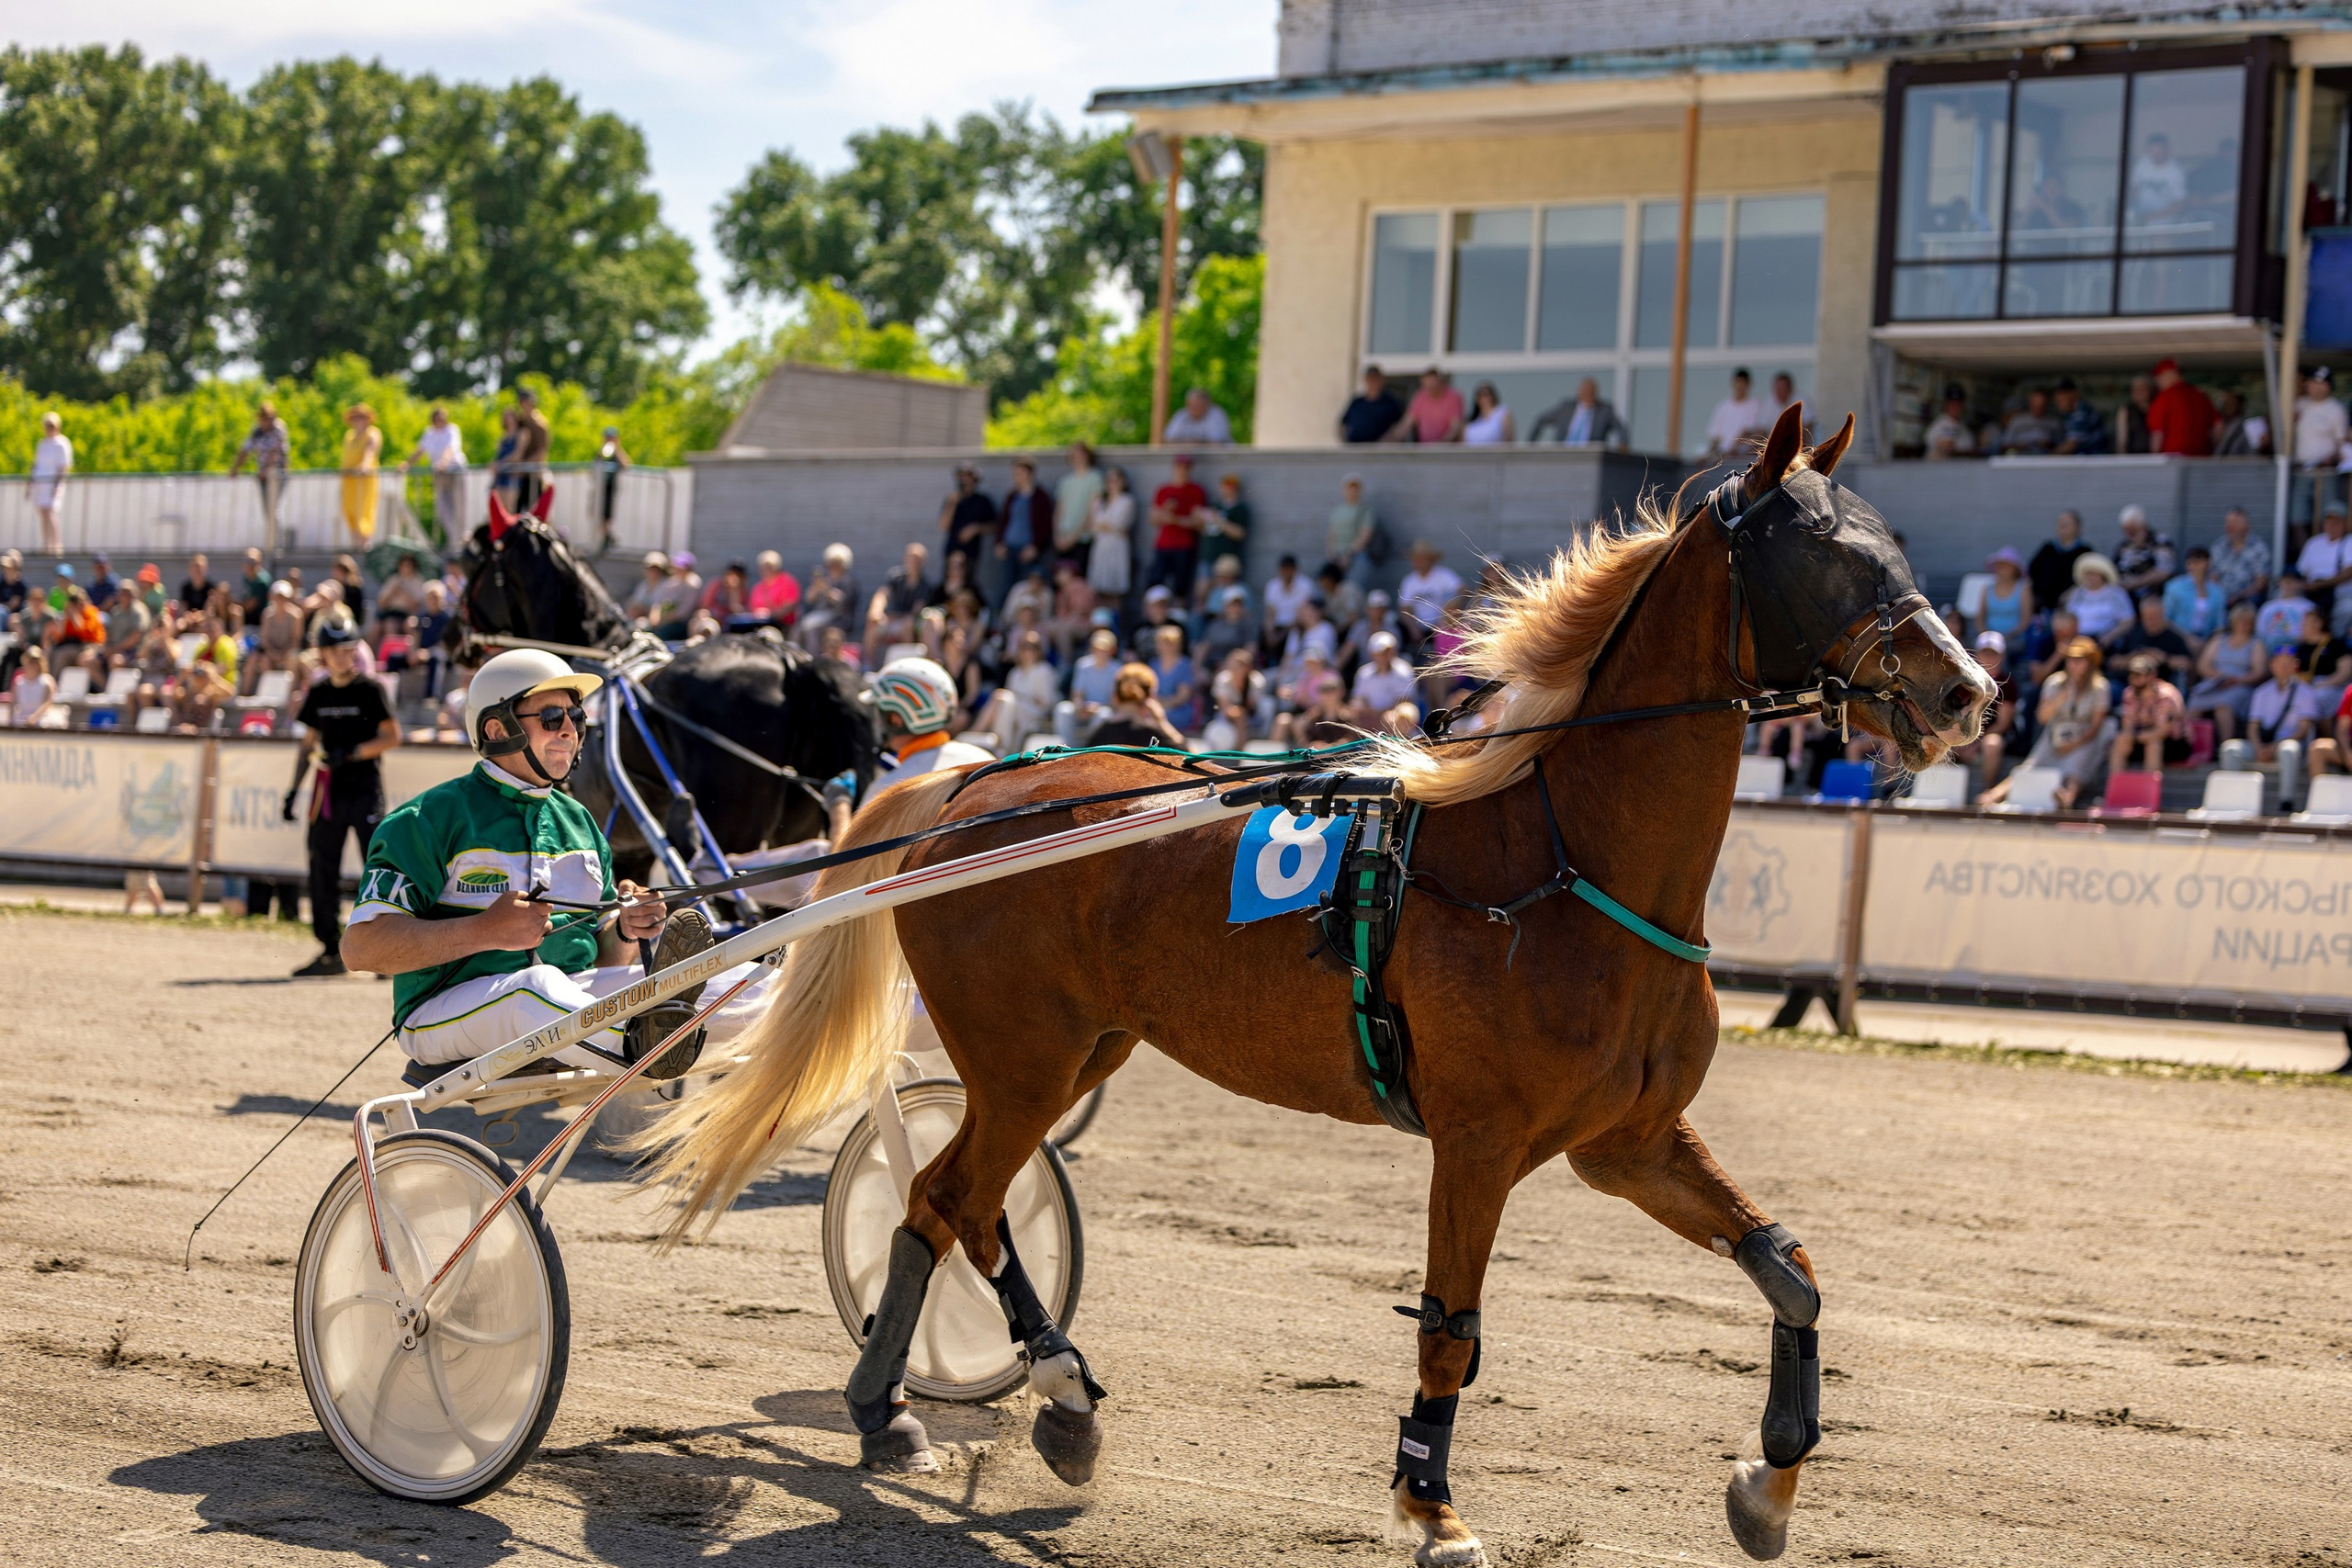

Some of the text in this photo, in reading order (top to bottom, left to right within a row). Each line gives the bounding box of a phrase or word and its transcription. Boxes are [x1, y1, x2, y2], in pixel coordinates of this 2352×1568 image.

[1256, 805, 1336, 899] 8
[581, 953, 723, 1029] CUSTOM MULTIFLEX
